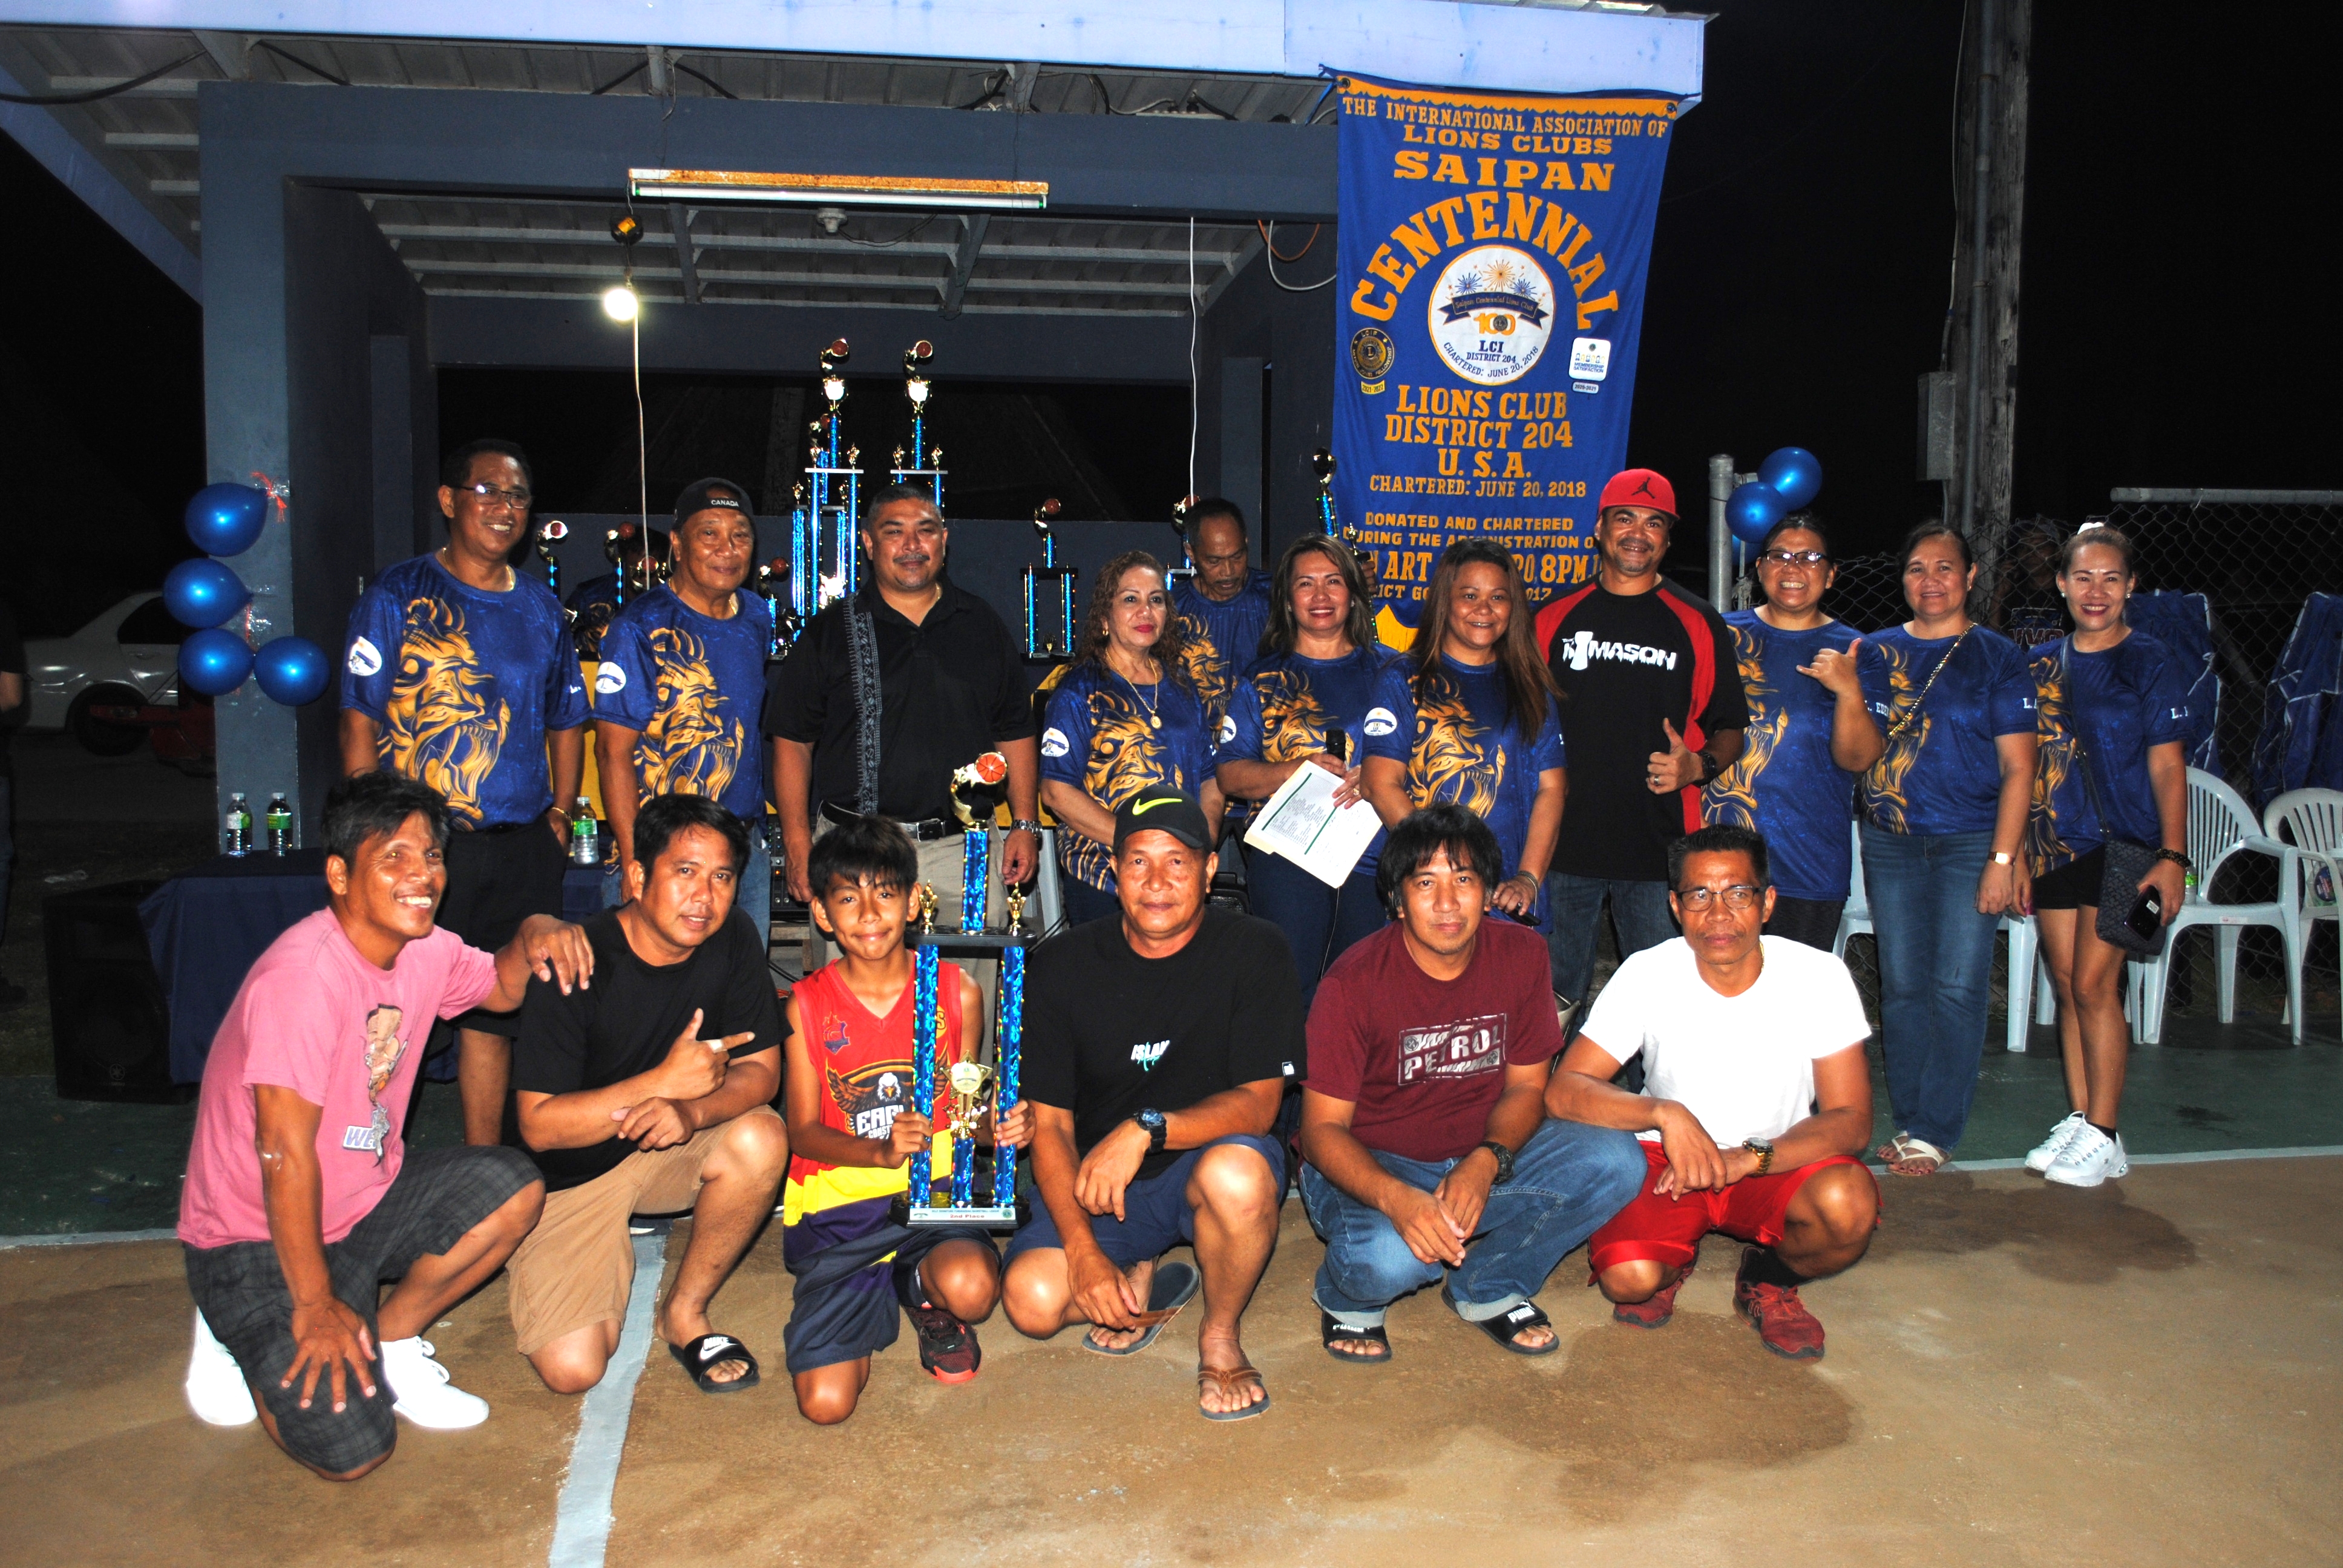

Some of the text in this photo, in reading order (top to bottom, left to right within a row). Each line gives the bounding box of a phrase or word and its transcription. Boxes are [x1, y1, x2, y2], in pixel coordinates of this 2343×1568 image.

[1343, 97, 1668, 138] THE INTERNATIONAL ASSOCIATION OF
[1403, 125, 1613, 155] LIONS CLUBS
[1394, 151, 1615, 192] SAIPAN
[1351, 191, 1619, 330] CENTENNIAL
[1443, 342, 1484, 376] CHARTERED:
[1487, 368, 1509, 377] JUNE
[1522, 345, 1539, 366] 2018
[1466, 352, 1516, 364] DISTRICT 204
[1478, 340, 1504, 353] LCI
[1397, 385, 1567, 420] LIONS CLUB
[1384, 414, 1573, 448] DISTRICT 204
[1369, 475, 1587, 499] CHARTERED: JUNE 20, 2018
[1365, 512, 1573, 531] DONATED AND CHARTERED
[1408, 533, 1441, 547] THE
[1383, 550, 1432, 582] ART
[1404, 1025, 1501, 1080] PETROL
[704, 1336, 729, 1351] NIKE
